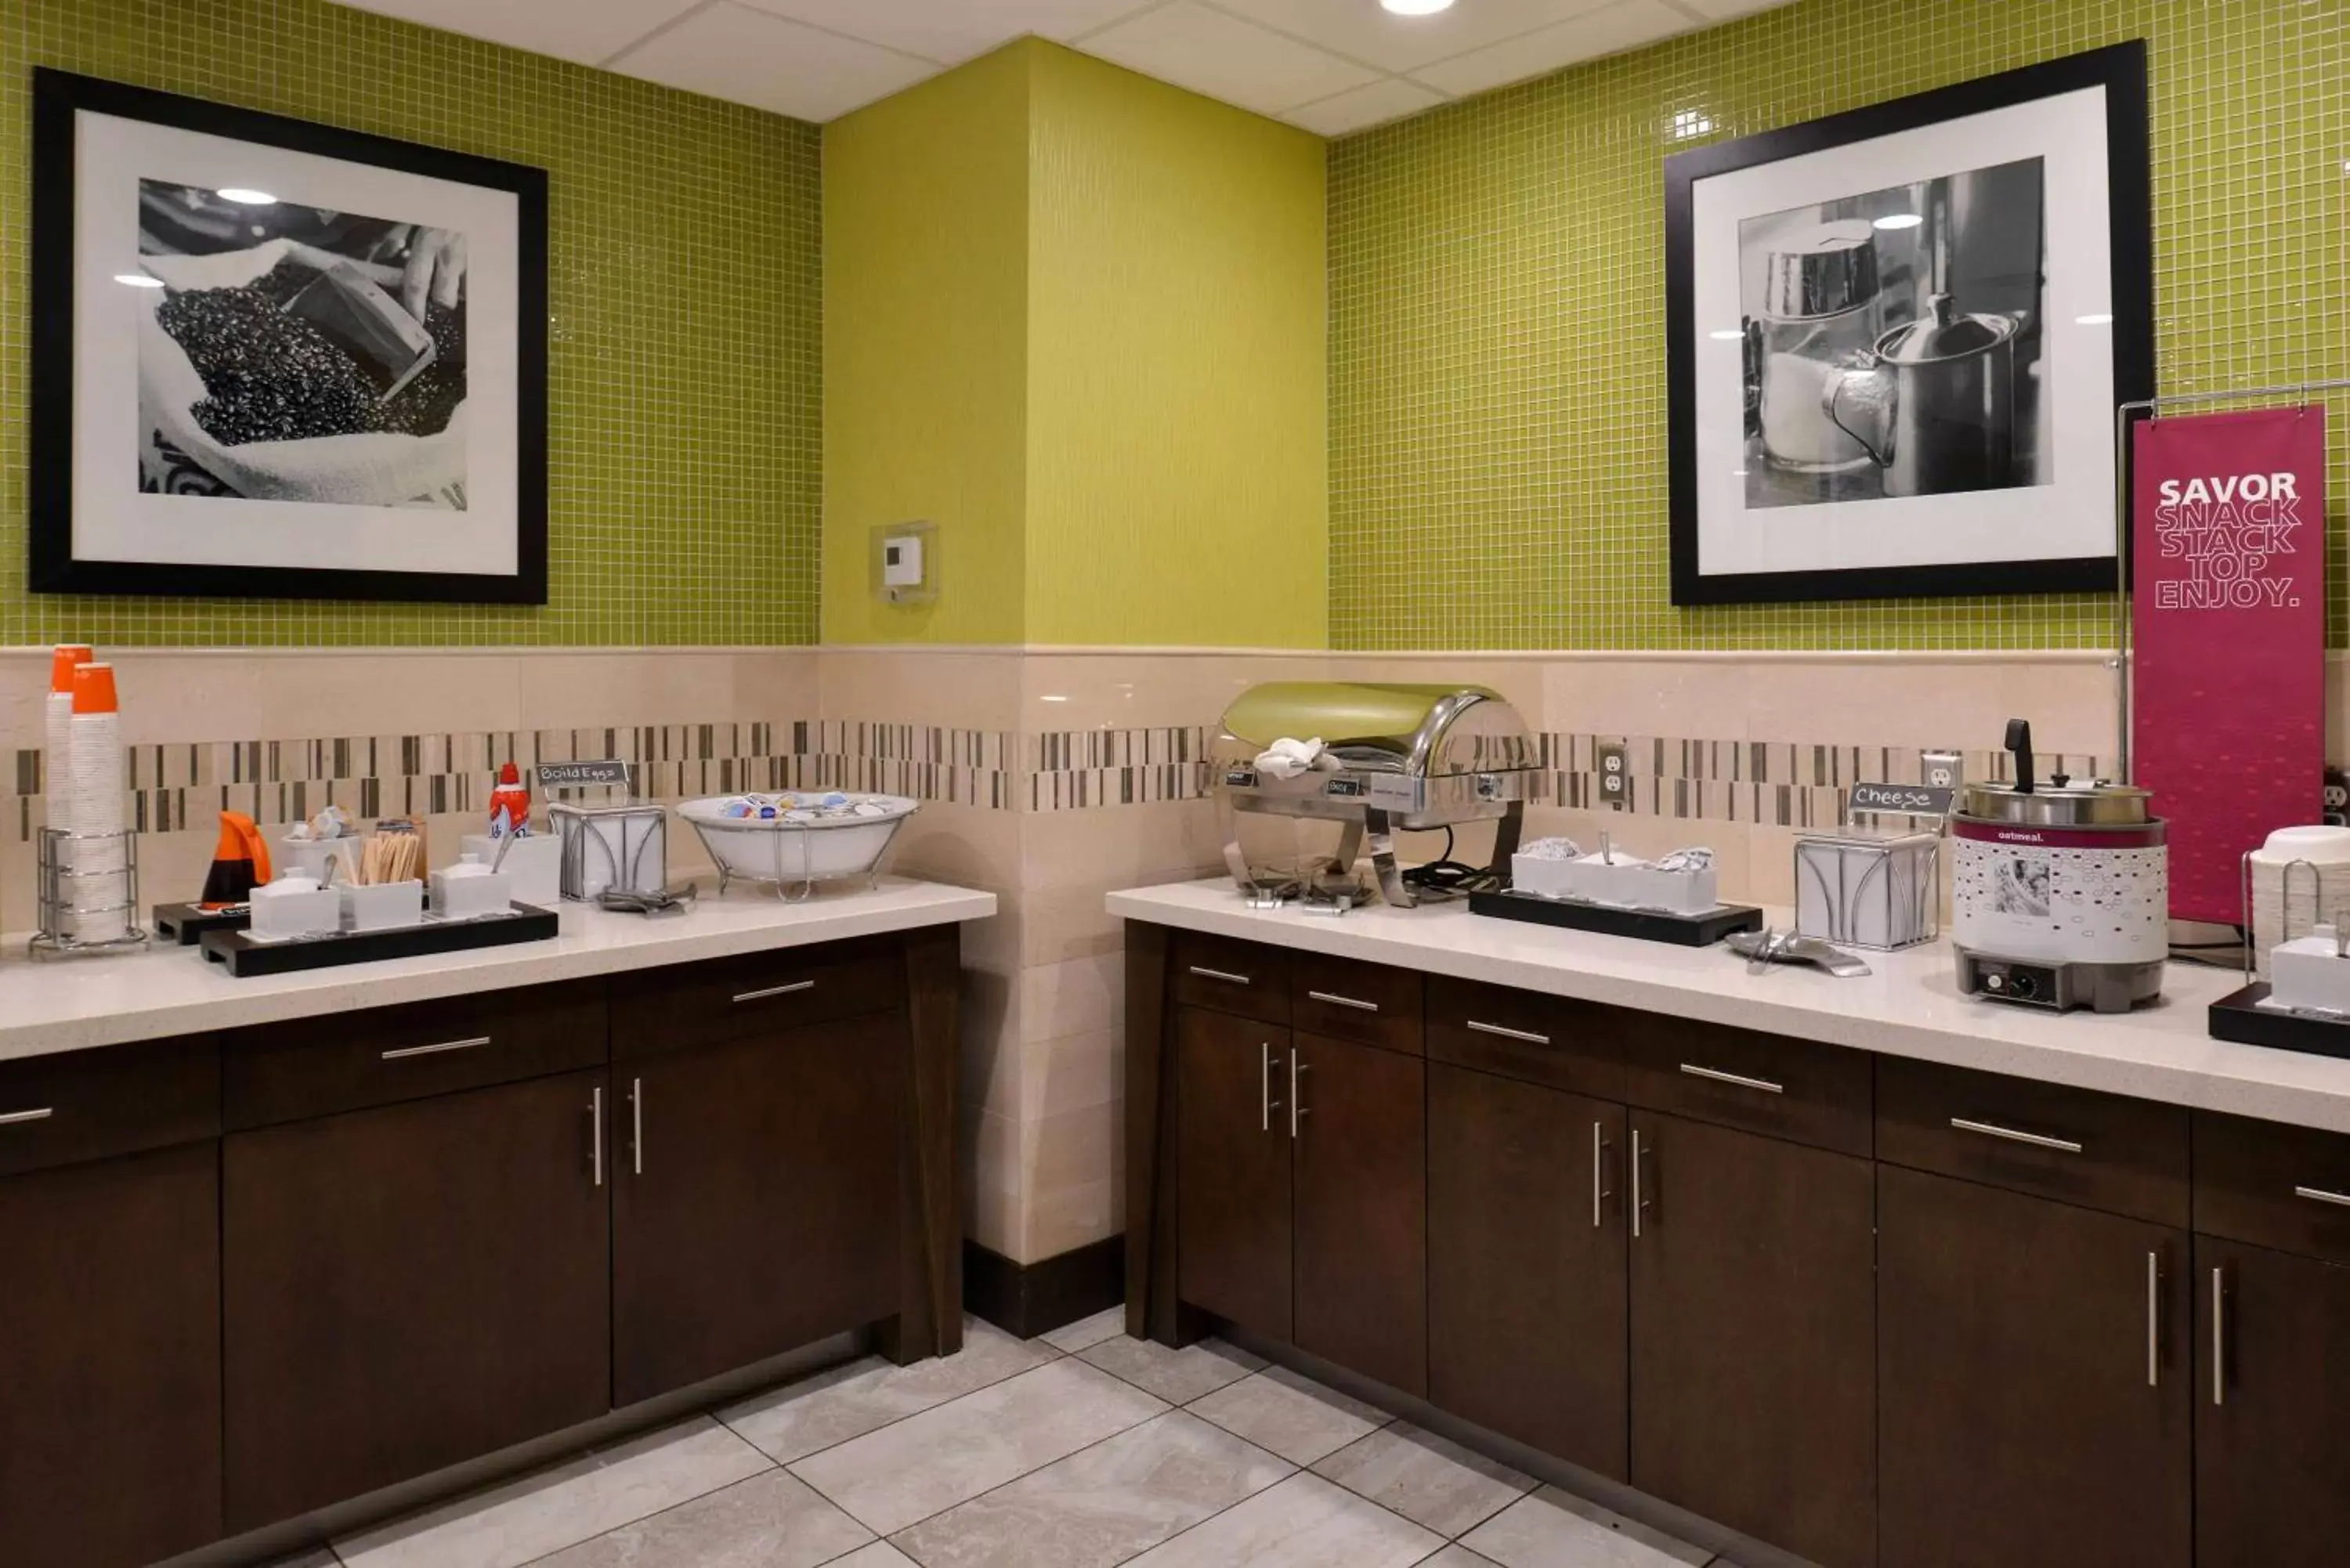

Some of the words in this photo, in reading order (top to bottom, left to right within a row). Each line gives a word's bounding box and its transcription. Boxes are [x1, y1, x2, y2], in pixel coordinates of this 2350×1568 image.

[2160, 472, 2297, 506] SAVOR
[2156, 497, 2302, 531] SNACK
[2160, 524, 2296, 558] STACK
[2186, 552, 2268, 581] TOP
[2156, 577, 2300, 609] ENJOY.
[1856, 788, 1931, 808] Cheese
